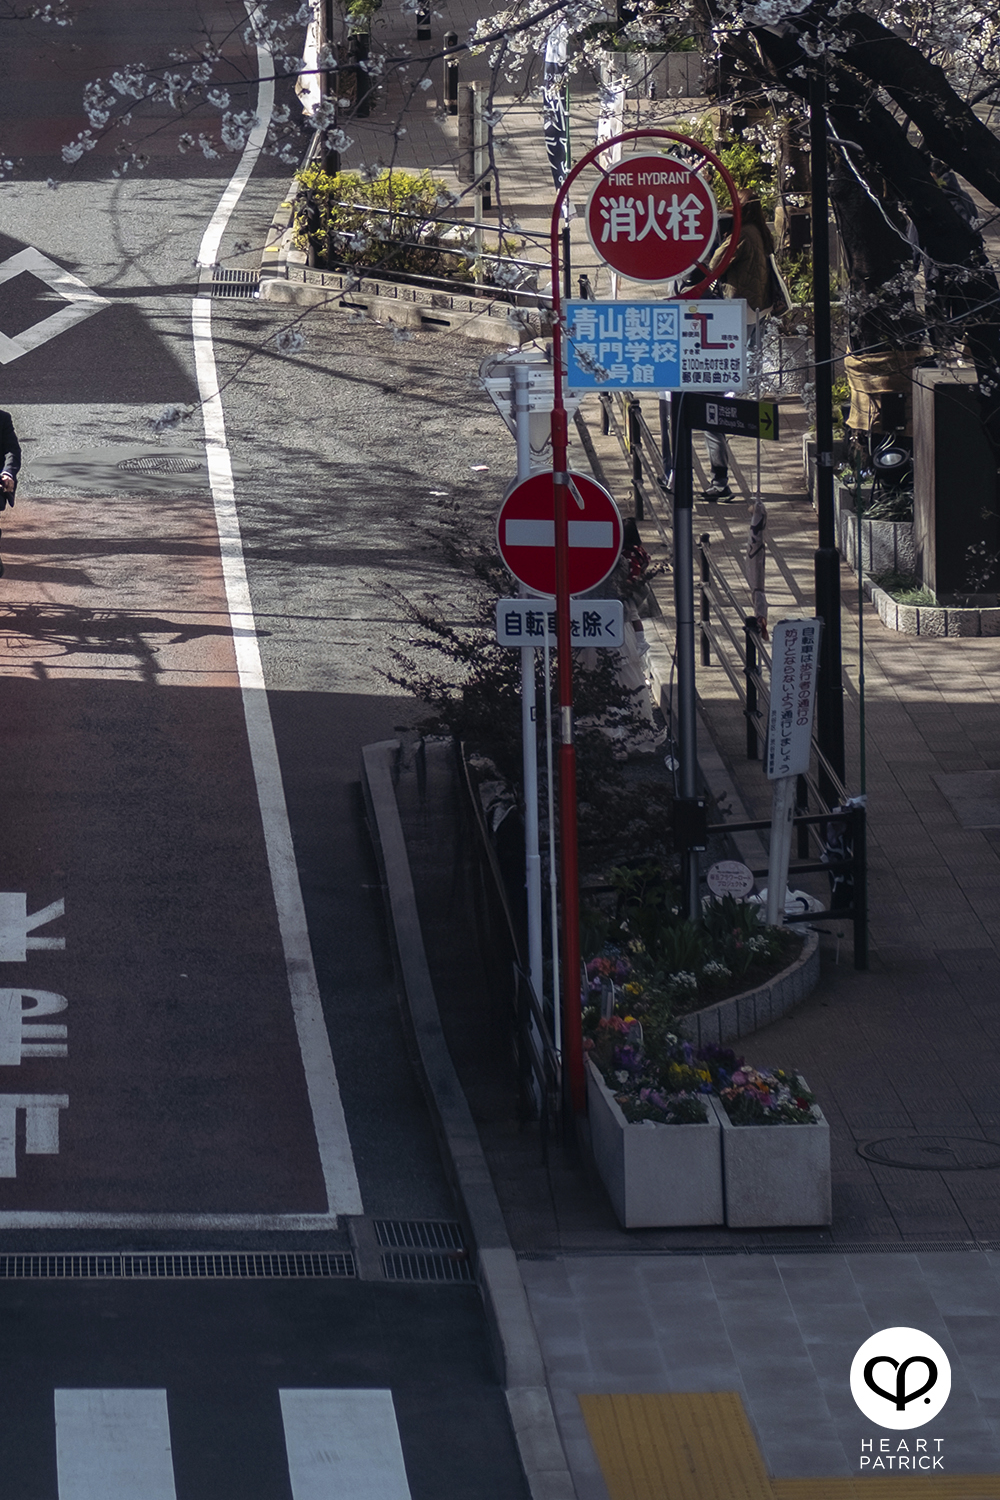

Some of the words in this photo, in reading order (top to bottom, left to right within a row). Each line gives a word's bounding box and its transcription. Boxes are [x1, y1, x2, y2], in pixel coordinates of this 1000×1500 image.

[608, 173, 633, 186] FIRE
[638, 171, 691, 185] HYDRANT
[599, 193, 704, 242] 消火栓
[572, 307, 679, 341] 青山製図
[596, 364, 655, 384] 号館
